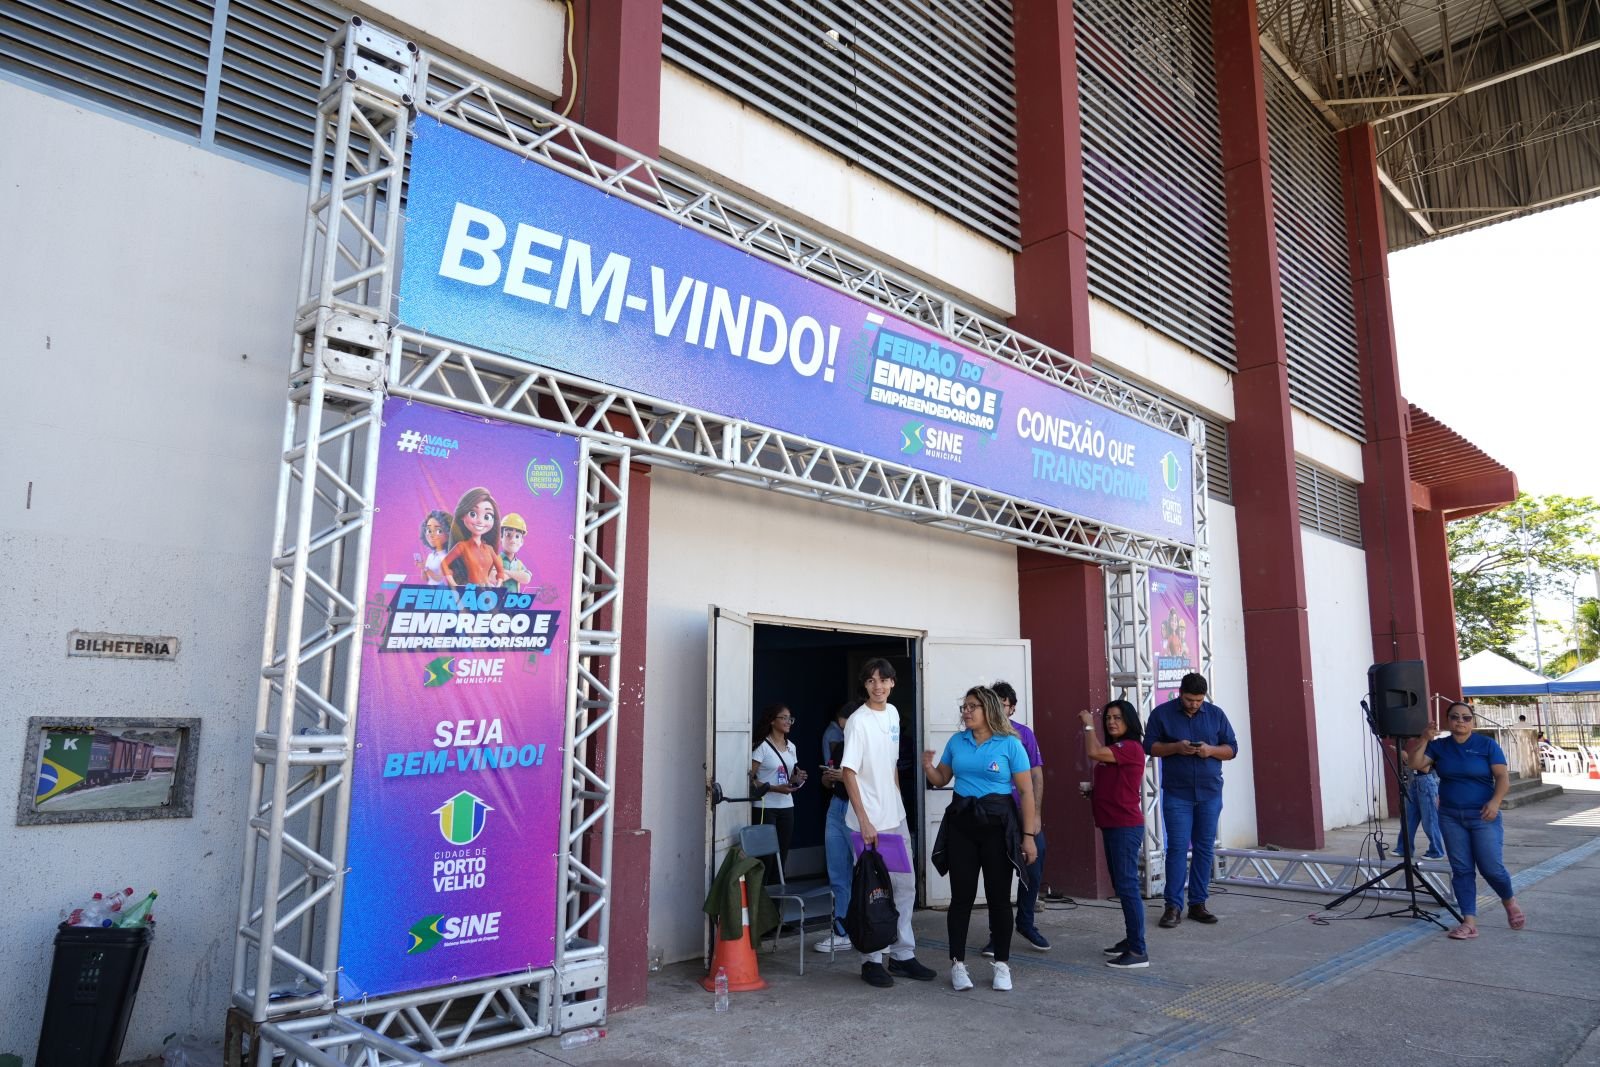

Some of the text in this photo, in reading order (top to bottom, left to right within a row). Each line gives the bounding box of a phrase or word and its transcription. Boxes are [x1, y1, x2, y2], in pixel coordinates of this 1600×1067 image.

[439, 202, 841, 383] BEM-VINDO!
[877, 332, 982, 382] FEIRÃO DO
[873, 358, 997, 415] EMPREGO E
[870, 386, 995, 431] EMPREENDEDORISMO
[1016, 407, 1136, 467] CONEXÃO QUE
[925, 449, 962, 463] MUNICIPAL
[1031, 447, 1150, 501] TRANSFORMA
[396, 584, 531, 611] FEIRÃO DO
[391, 612, 552, 634] EMPREGO E
[75, 639, 170, 655] BILHETERIA
[386, 636, 548, 649] EMPREENDEDORISMO
[433, 718, 503, 748] SEJA
[383, 743, 546, 778] BEM-VINDO!
[433, 856, 486, 877] PORTO
[434, 848, 487, 860] CIDADE DE
[433, 872, 486, 893] VELHO
